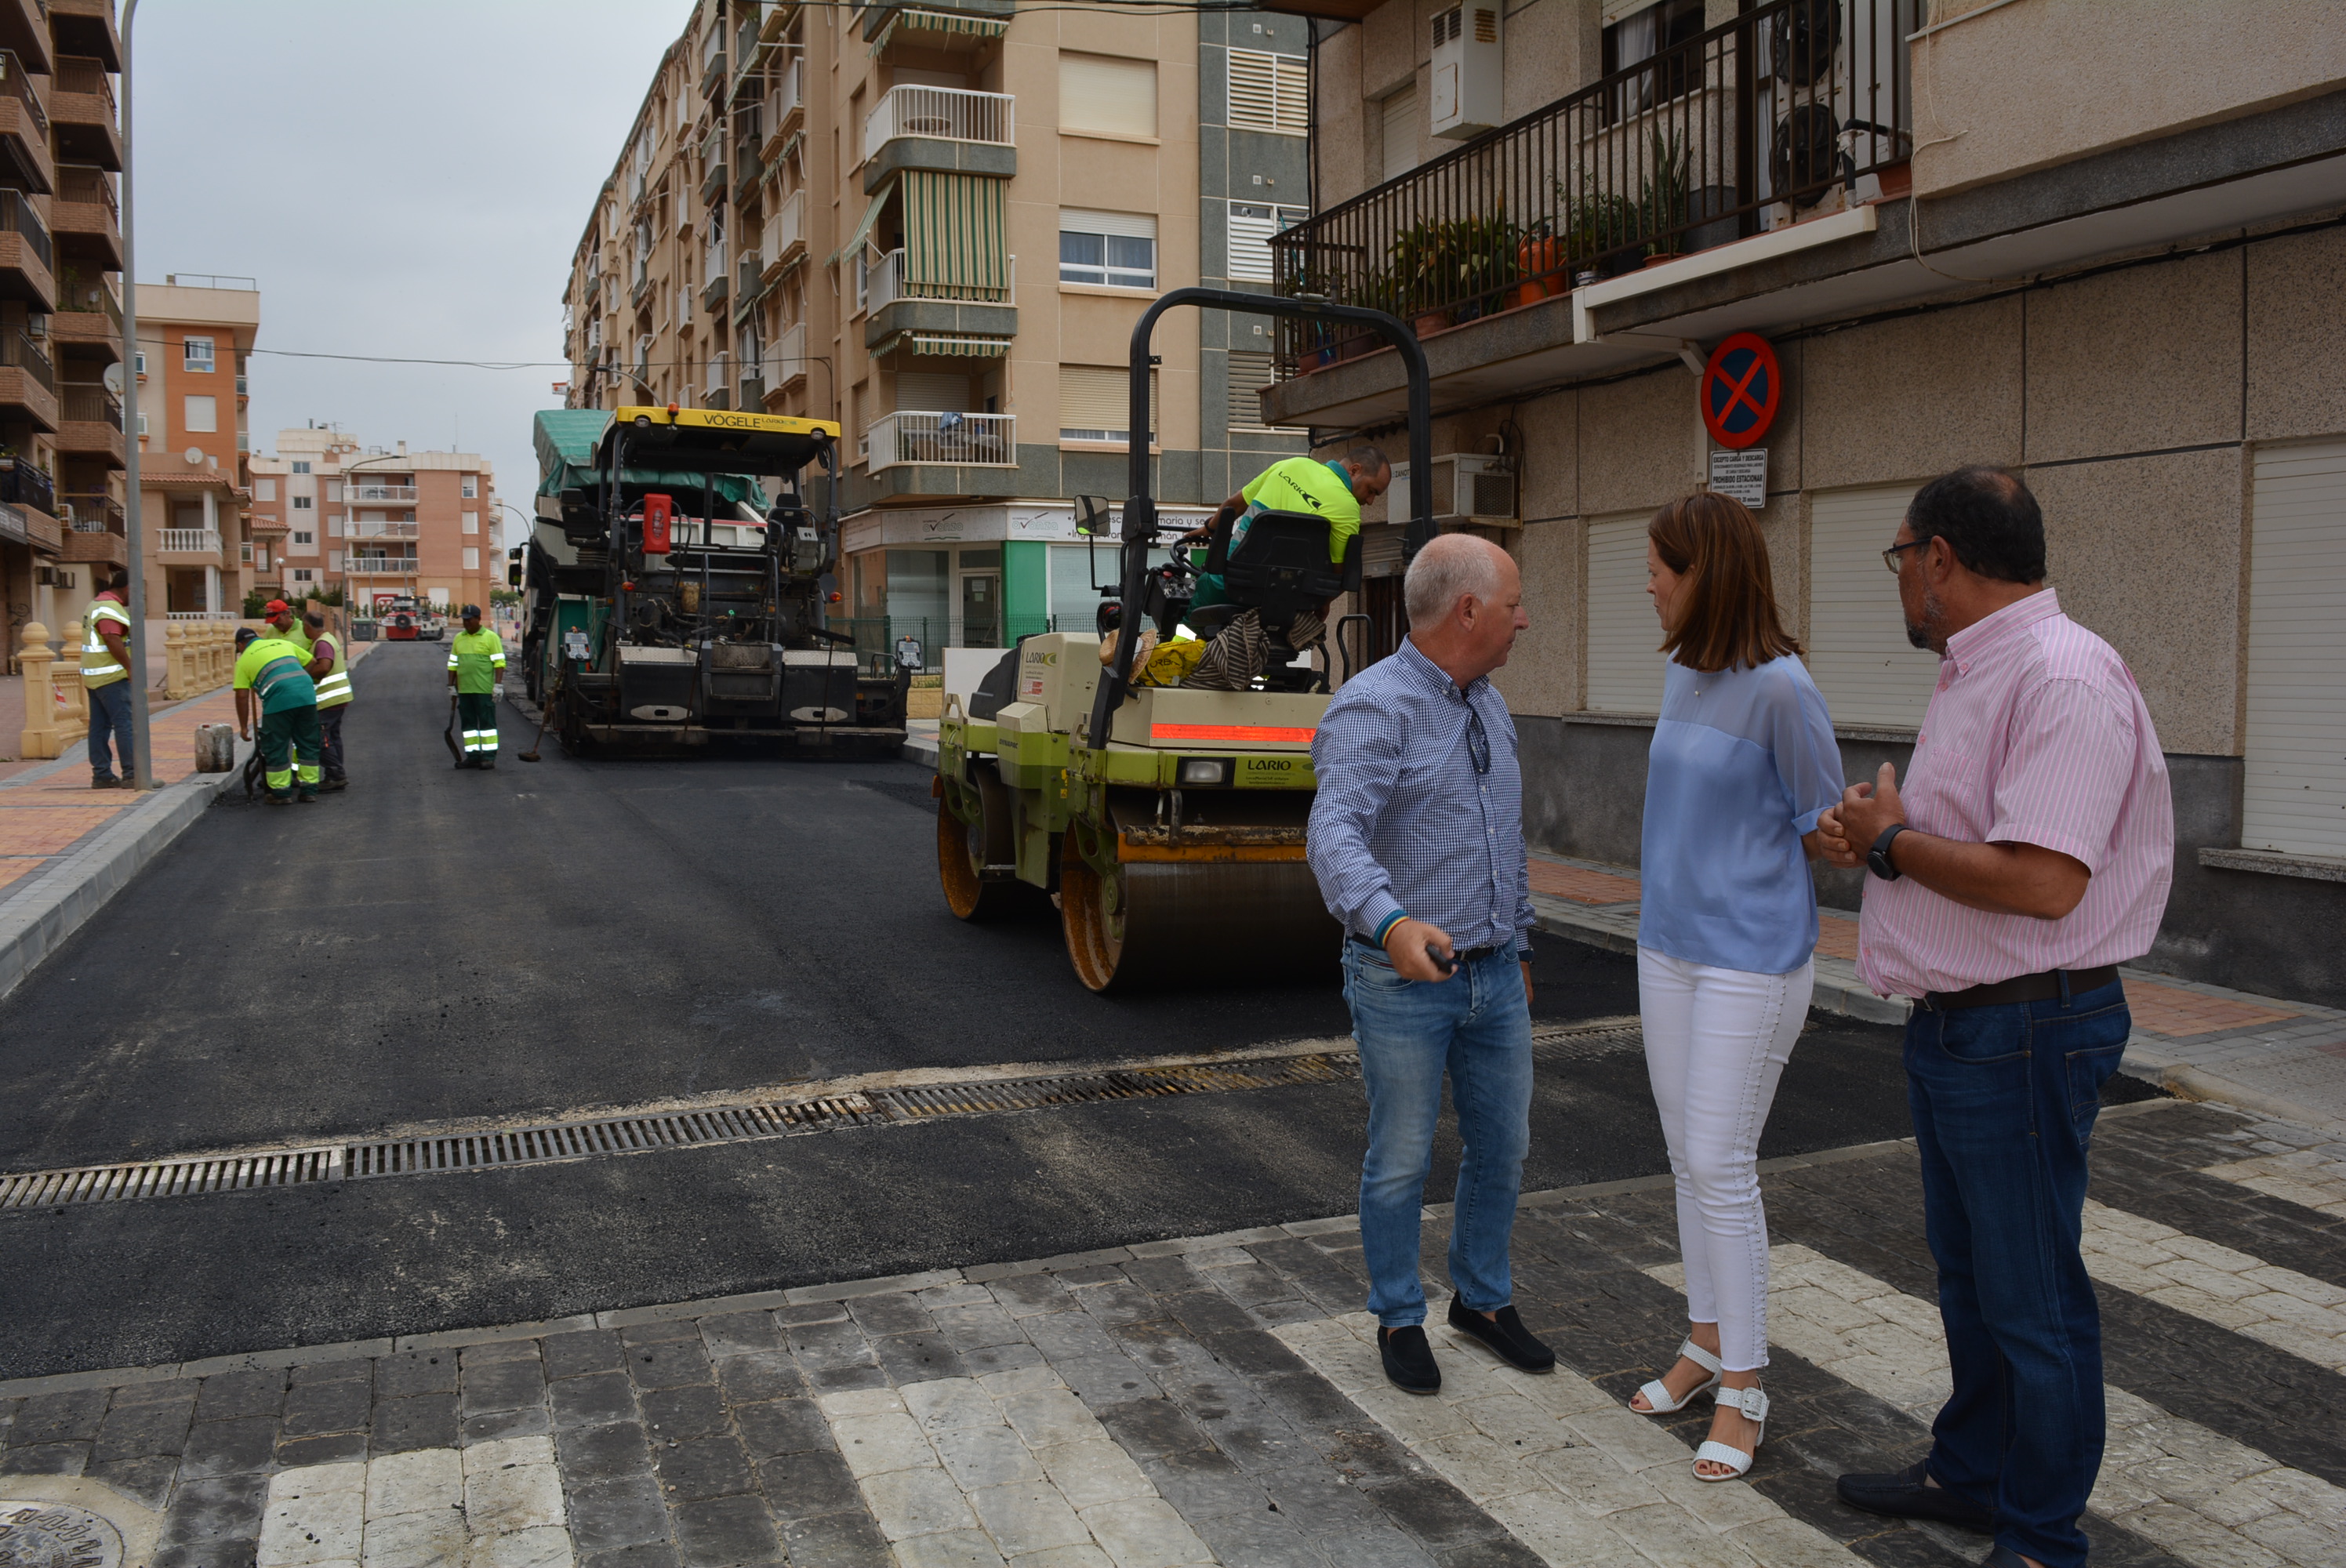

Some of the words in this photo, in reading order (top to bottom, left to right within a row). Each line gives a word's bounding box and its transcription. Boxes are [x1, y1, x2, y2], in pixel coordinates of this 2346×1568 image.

[703, 412, 761, 429] VÖGELE
[1395, 468, 1410, 477] ZANOT
[1278, 471, 1307, 496] LARIO
[922, 520, 964, 532] avanza
[1011, 518, 1059, 531] avanza
[1158, 516, 1184, 525] maria
[1026, 652, 1045, 664] LARIO
[1247, 759, 1291, 771] LARIO
